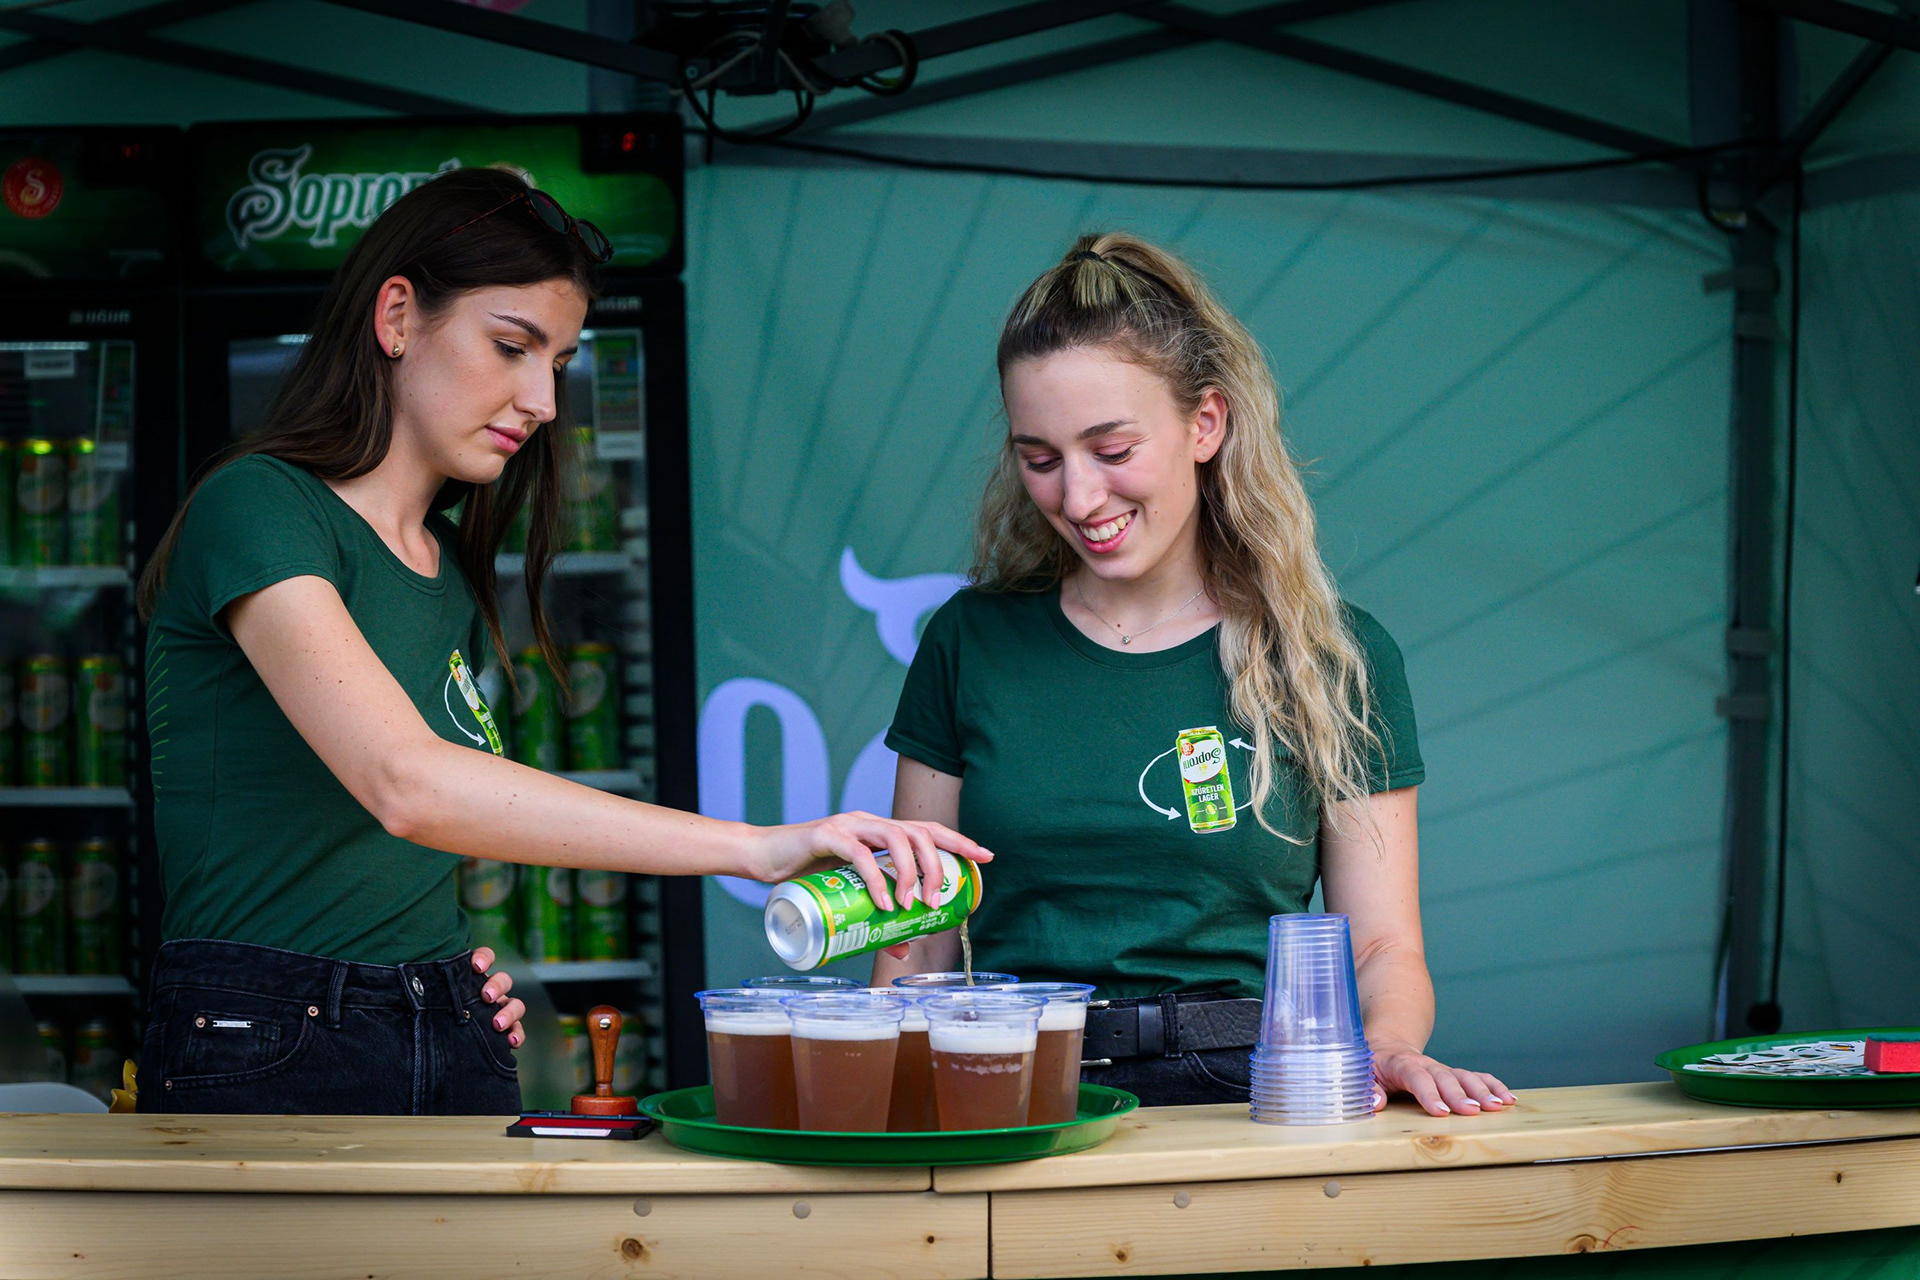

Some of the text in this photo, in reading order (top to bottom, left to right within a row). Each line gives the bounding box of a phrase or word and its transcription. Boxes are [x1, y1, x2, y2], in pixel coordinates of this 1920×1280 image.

[226, 142, 462, 250] Sopro
[1198, 792, 1220, 802] LAGER
[834, 867, 867, 892] LAGER
